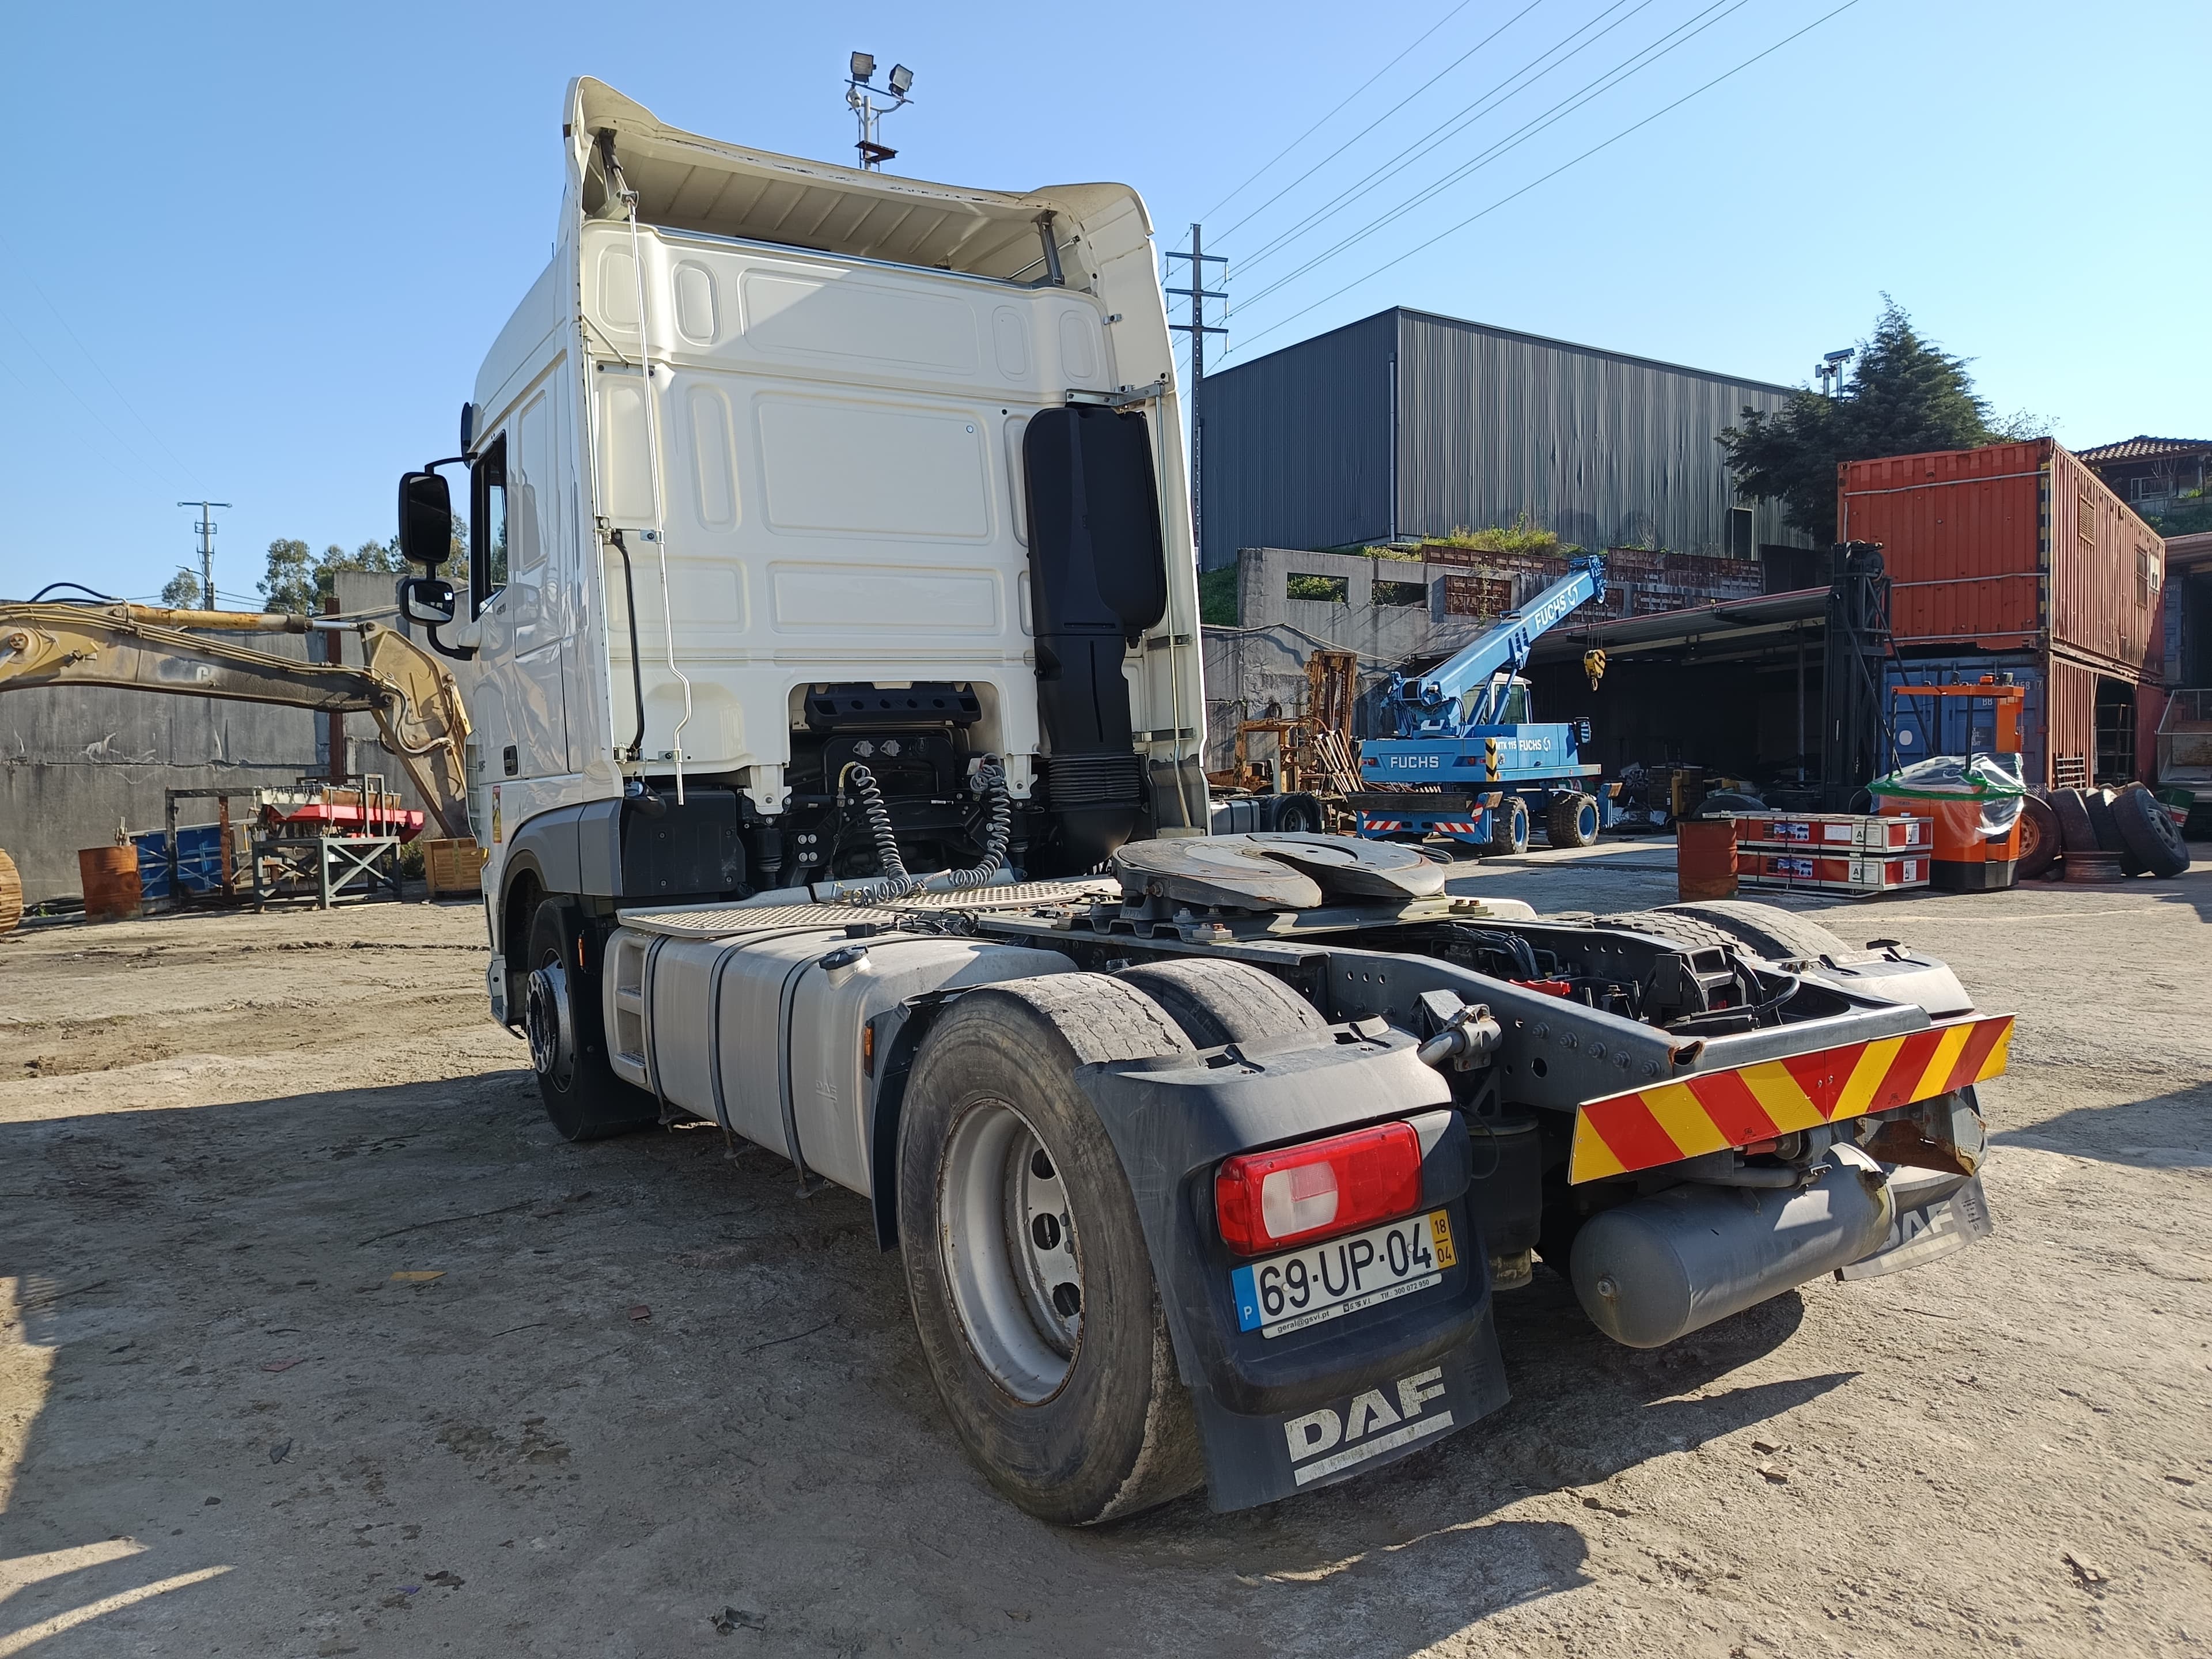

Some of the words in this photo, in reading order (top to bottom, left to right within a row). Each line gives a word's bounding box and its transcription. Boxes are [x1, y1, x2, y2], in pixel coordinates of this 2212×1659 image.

[1534, 594, 1566, 631] FUCHS
[1495, 741, 1508, 750] MTK
[1508, 741, 1517, 749] 115
[1519, 738, 1542, 751] FUCHS
[1391, 756, 1439, 768] FUCHS
[1434, 1219, 1447, 1235] 18
[1437, 1248, 1452, 1263] 04
[1244, 1306, 1252, 1320] P
[1277, 1310, 1330, 1333] geral@gsvi.pt
[1394, 1286, 1406, 1296] 300
[1406, 1283, 1418, 1291] 072
[1419, 1279, 1430, 1288] 950
[1283, 1366, 1446, 1463] DAF
